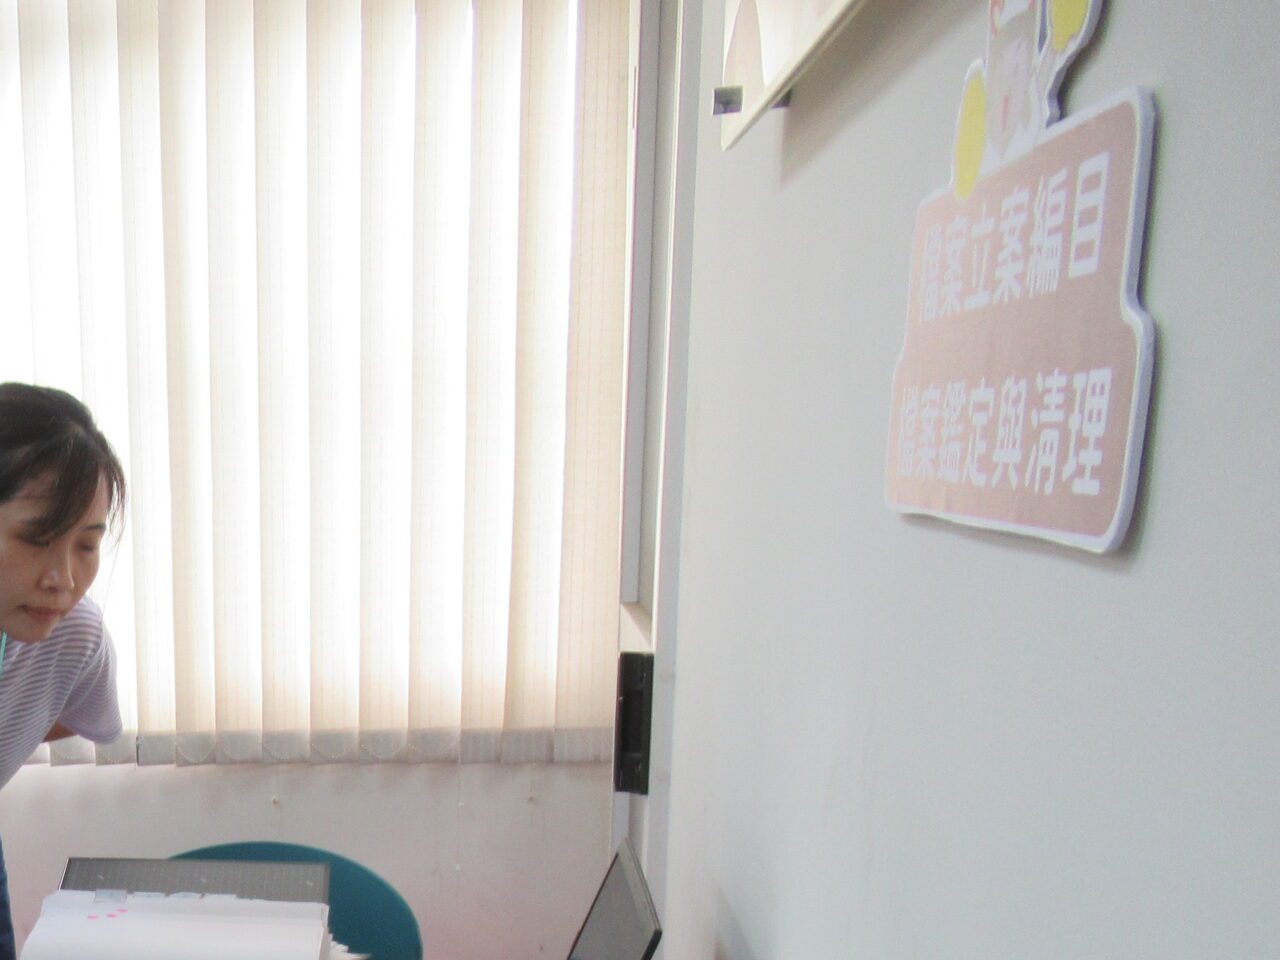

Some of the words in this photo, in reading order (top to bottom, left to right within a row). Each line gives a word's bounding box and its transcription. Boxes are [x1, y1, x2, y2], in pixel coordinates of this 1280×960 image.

[920, 151, 1109, 321] 檔案立案編目
[897, 366, 1112, 496] 檔案鑑定與清理
